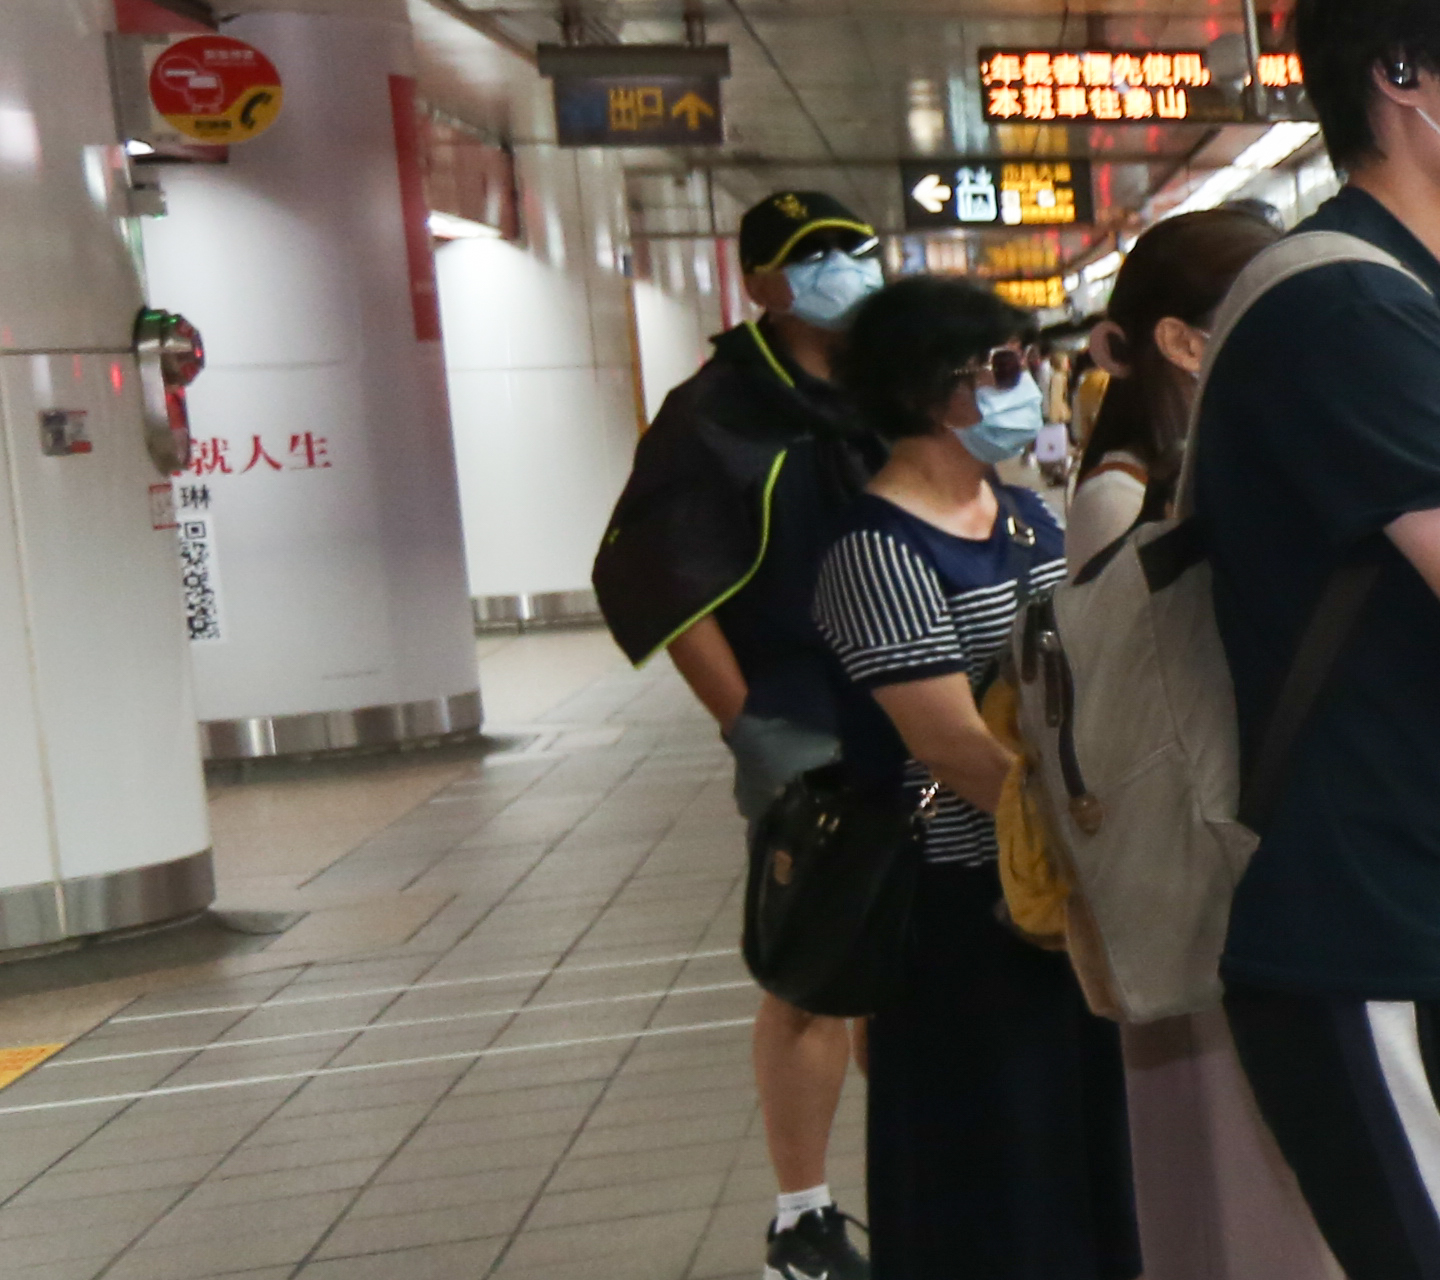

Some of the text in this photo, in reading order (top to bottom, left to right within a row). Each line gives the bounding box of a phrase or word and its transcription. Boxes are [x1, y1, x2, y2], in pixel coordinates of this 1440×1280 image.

[988, 86, 1188, 119] 本班車往象山
[172, 431, 332, 478] 就人生
